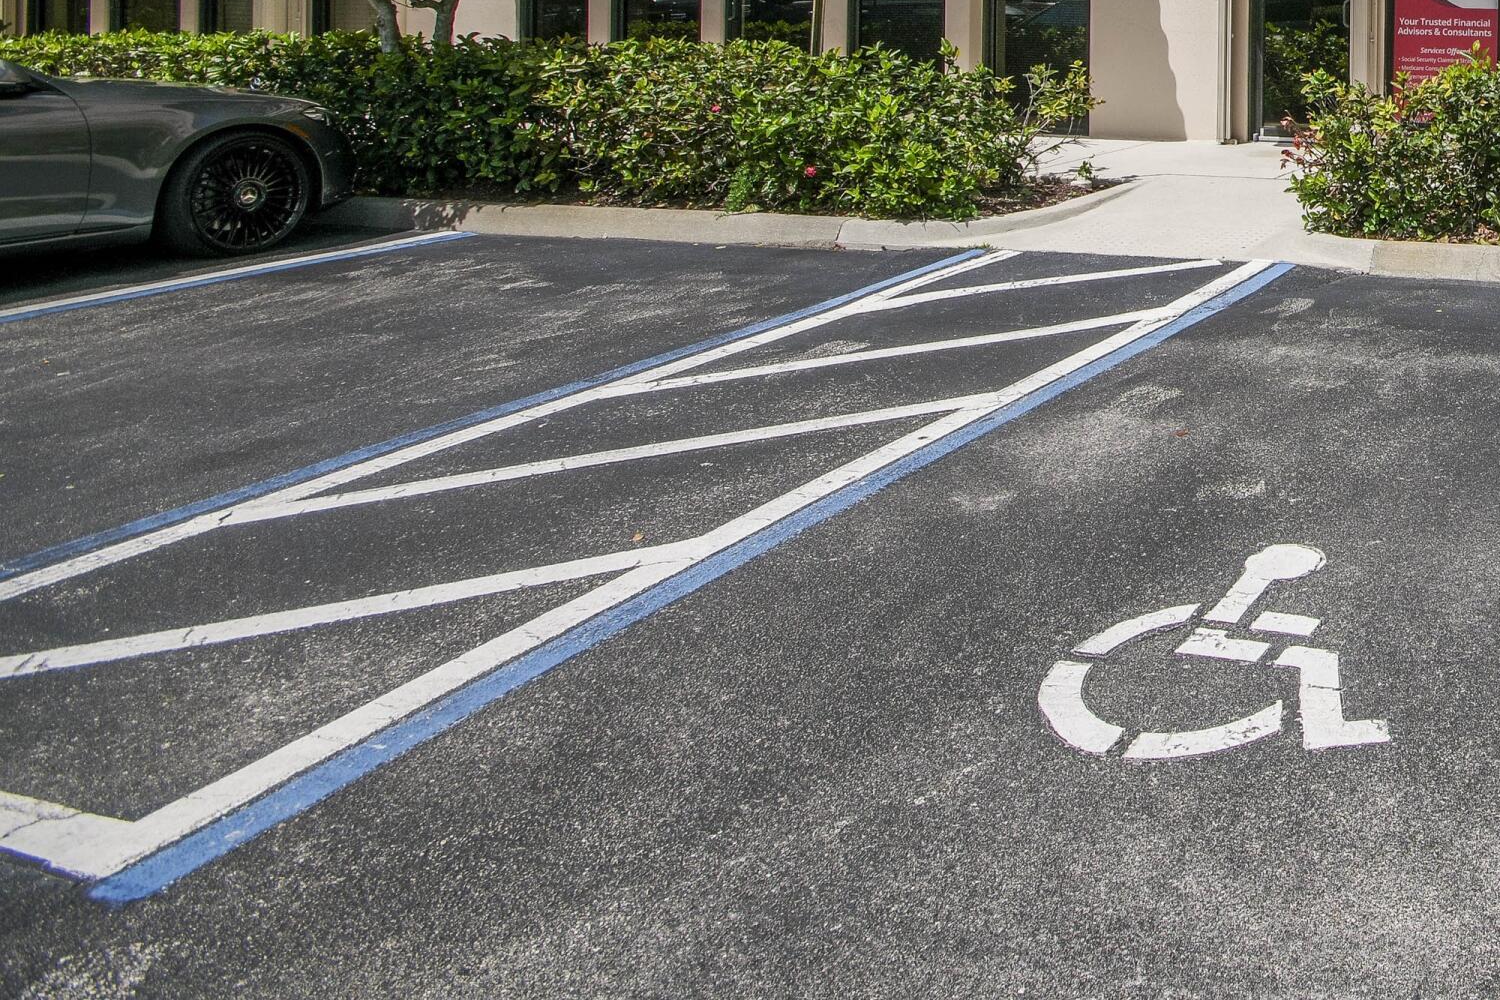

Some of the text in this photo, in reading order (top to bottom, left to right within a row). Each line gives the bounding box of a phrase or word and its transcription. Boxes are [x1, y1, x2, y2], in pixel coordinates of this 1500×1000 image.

[1420, 18, 1452, 26] Trusted
[1454, 18, 1490, 27] Financial
[1398, 27, 1432, 36] Advisors
[1442, 28, 1492, 37] Consultants
